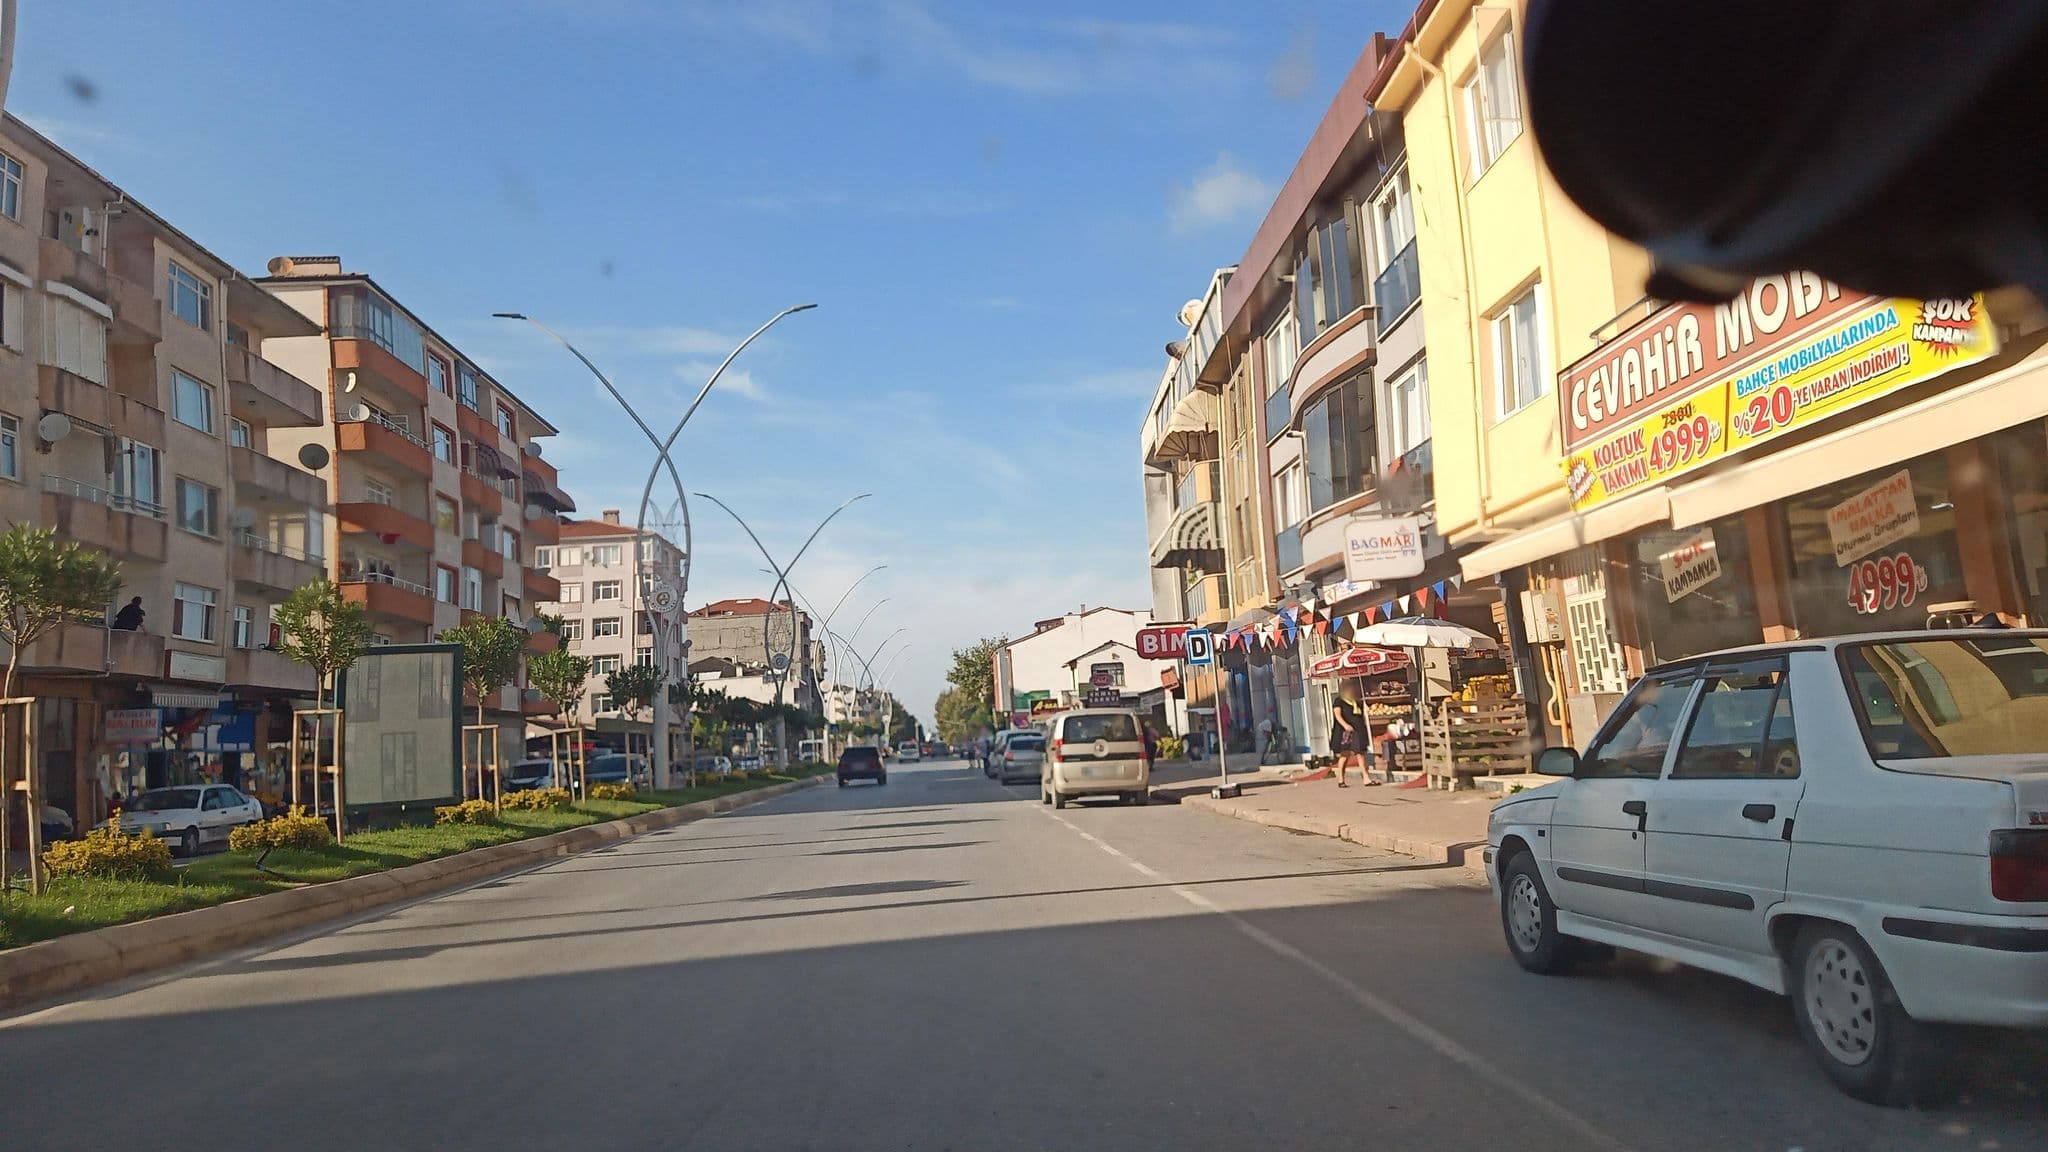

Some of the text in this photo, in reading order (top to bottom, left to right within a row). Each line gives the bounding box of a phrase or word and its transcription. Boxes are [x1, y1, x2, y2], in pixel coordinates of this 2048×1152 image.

[1736, 363, 1776, 397] BAHÇE
[1811, 374, 1848, 398] VARAN
[1593, 428, 1645, 469] KOLTUK
[1600, 457, 1649, 493] TAKIMI
[1668, 556, 1718, 597] KAMPANYA
[1143, 630, 1187, 654] BİM
[1191, 637, 1206, 658] D
